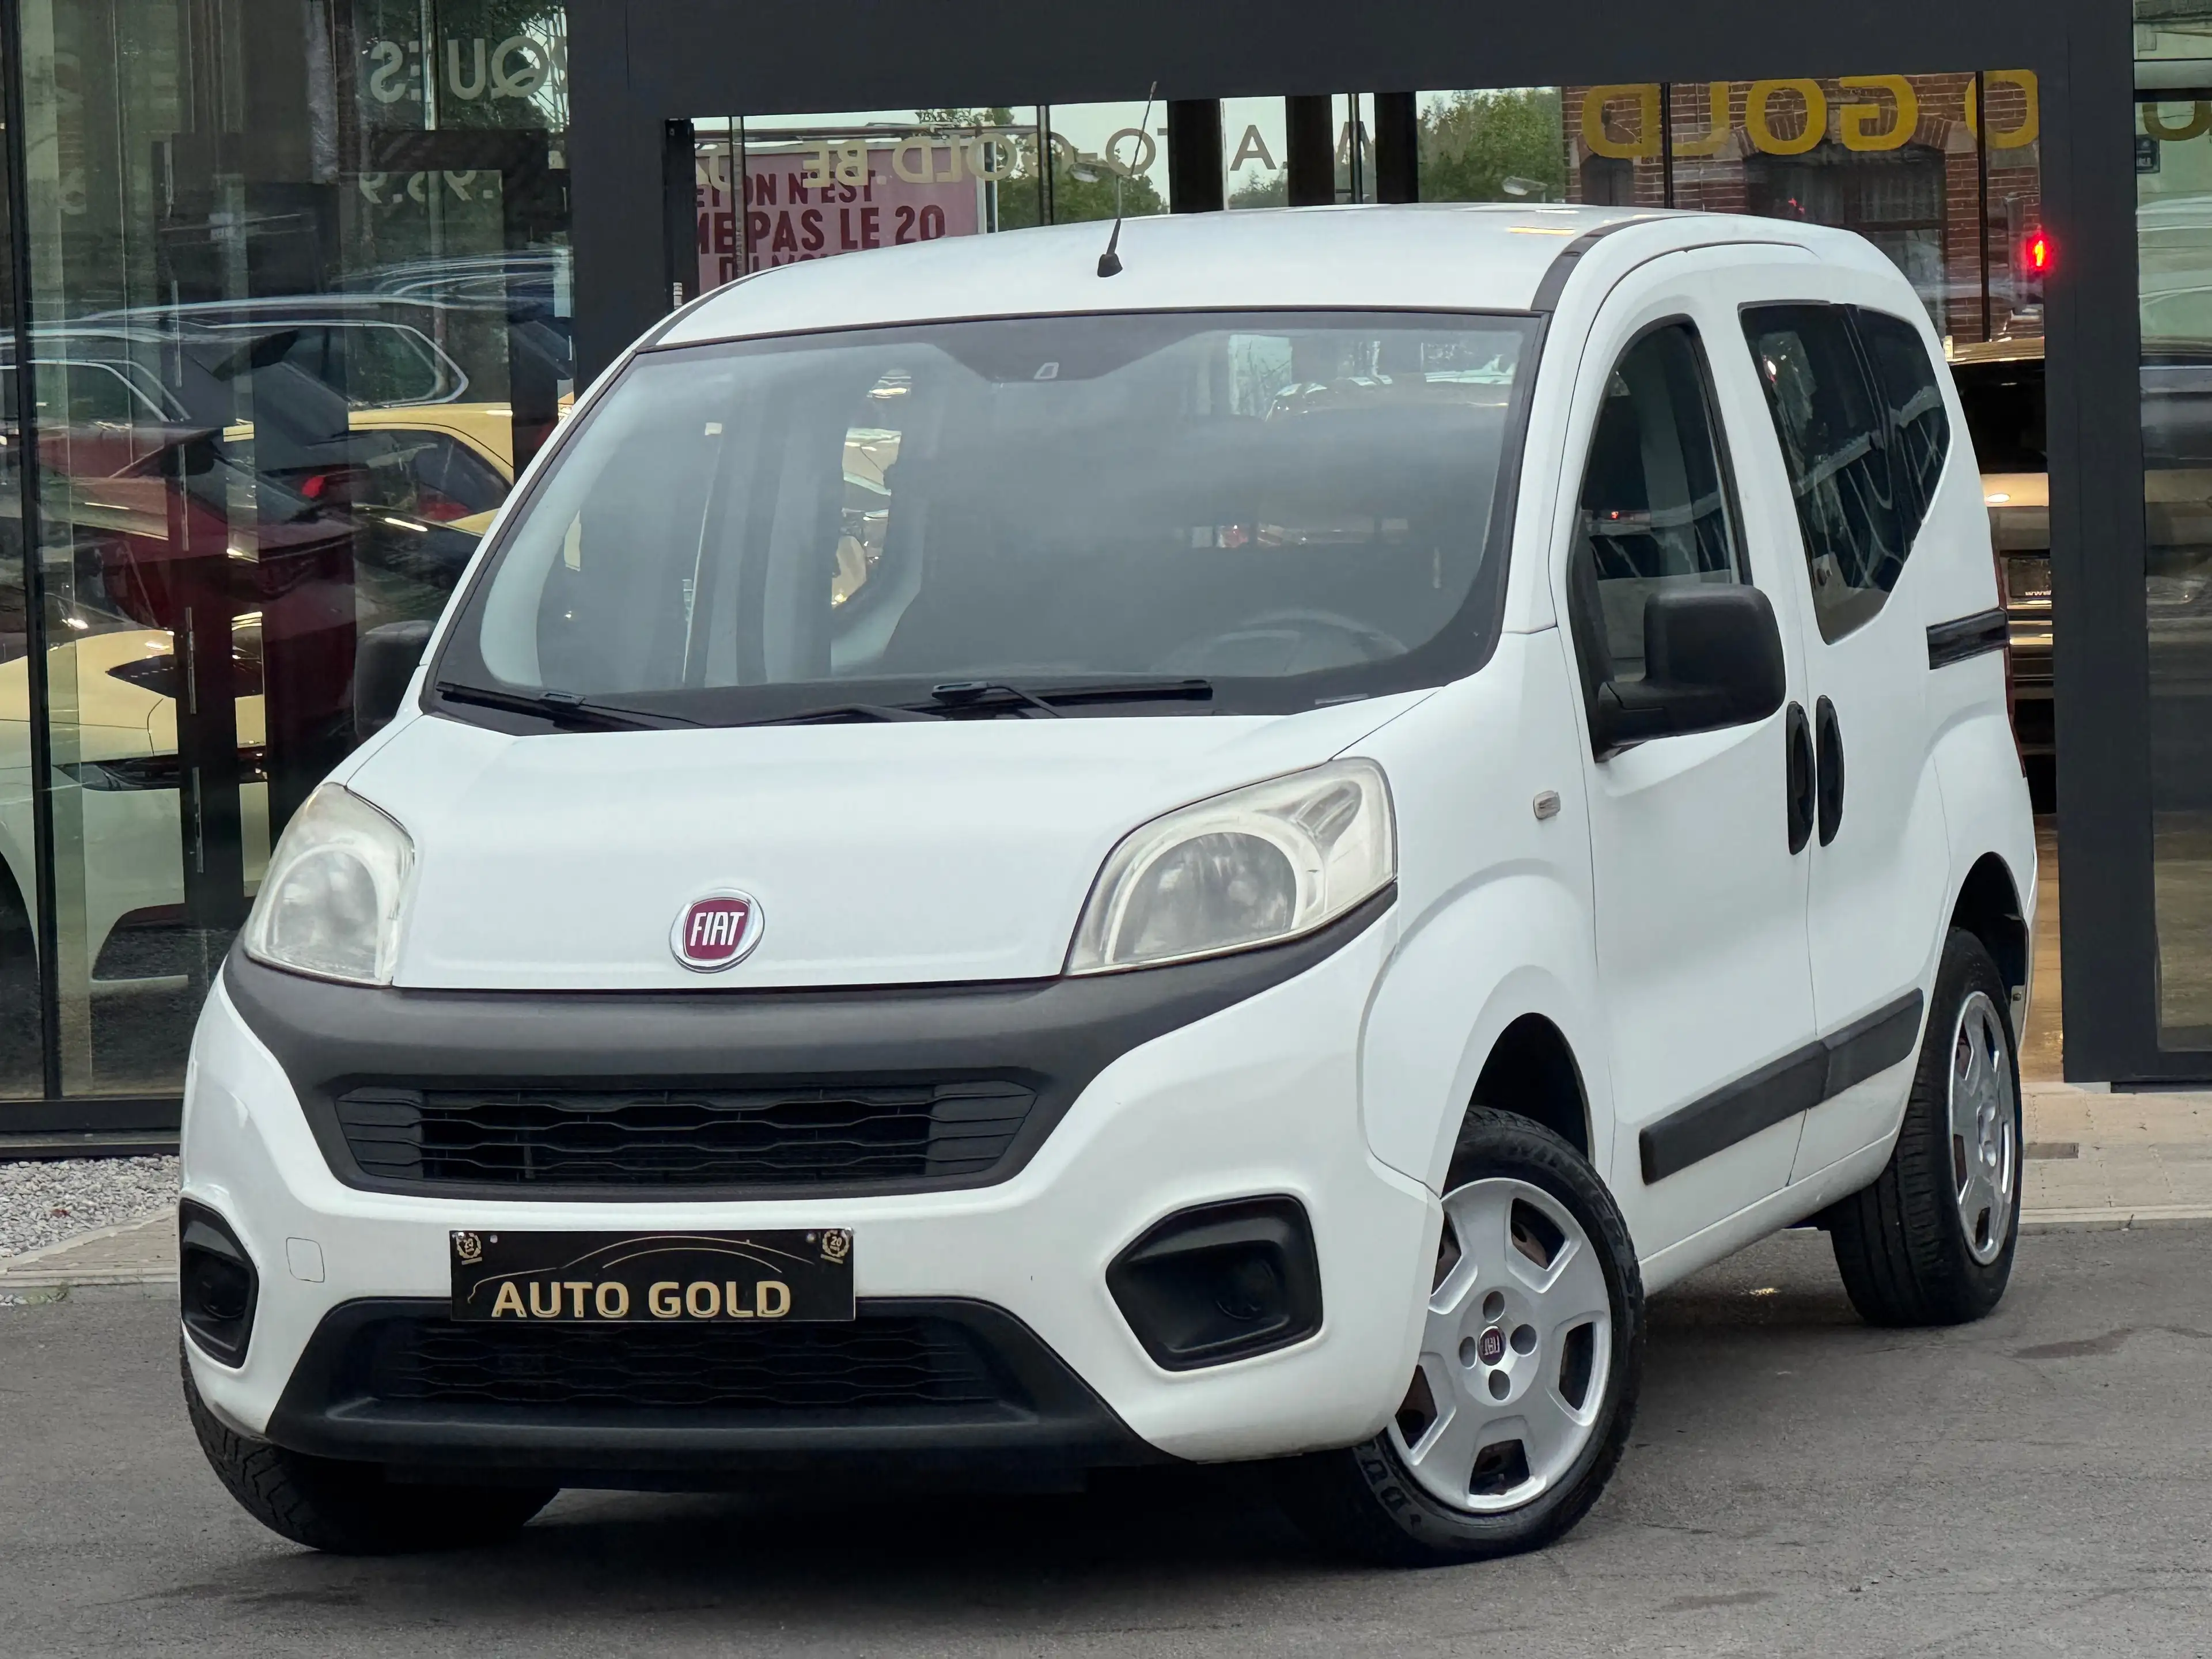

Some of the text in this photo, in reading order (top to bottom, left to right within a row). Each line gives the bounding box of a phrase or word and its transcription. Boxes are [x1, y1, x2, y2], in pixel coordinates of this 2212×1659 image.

[746, 208, 825, 252] PAS
[839, 207, 880, 250] LE
[895, 204, 946, 245] 20
[690, 911, 745, 946] FIAT
[491, 1281, 791, 1319] AUTO GOLD
